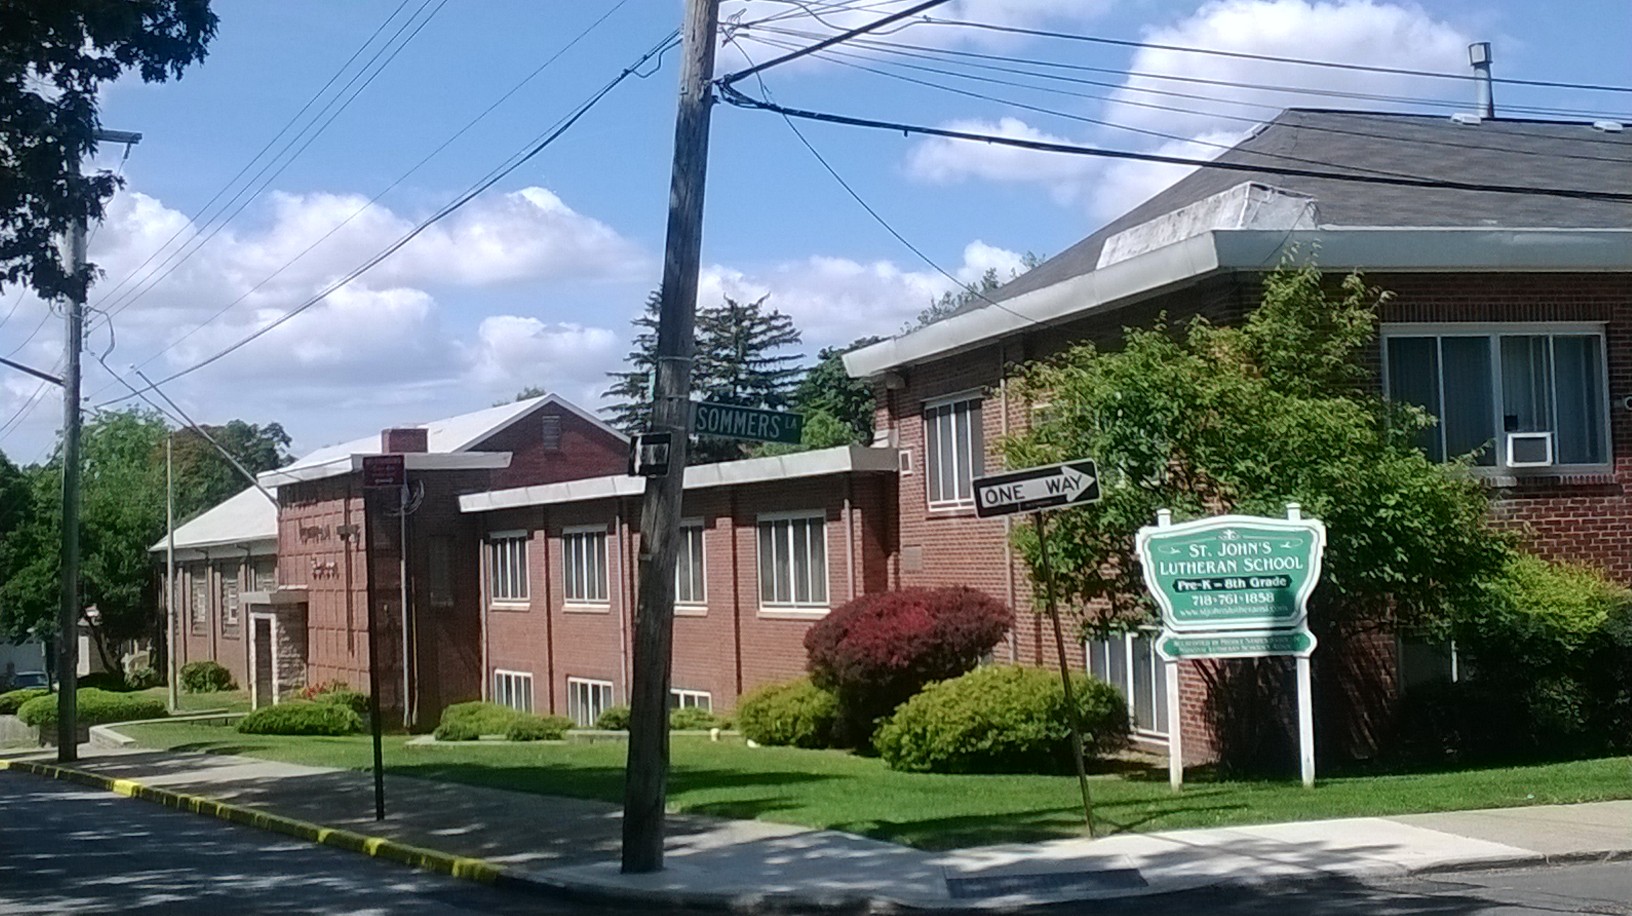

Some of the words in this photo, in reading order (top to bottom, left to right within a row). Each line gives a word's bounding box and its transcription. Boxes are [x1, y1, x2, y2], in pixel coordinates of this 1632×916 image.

[696, 407, 780, 438] SOMMERS
[784, 416, 798, 429] LA
[985, 484, 1025, 505] ONE
[1045, 474, 1083, 495] WAY
[1189, 543, 1213, 558] ST.
[1217, 541, 1272, 557] JOHN'S
[1159, 559, 1238, 576] LUTHERAN
[1243, 556, 1304, 572] SCHOOL
[1177, 579, 1212, 591] Pre-K
[1224, 578, 1246, 589] 8th
[1249, 576, 1287, 588] Grade
